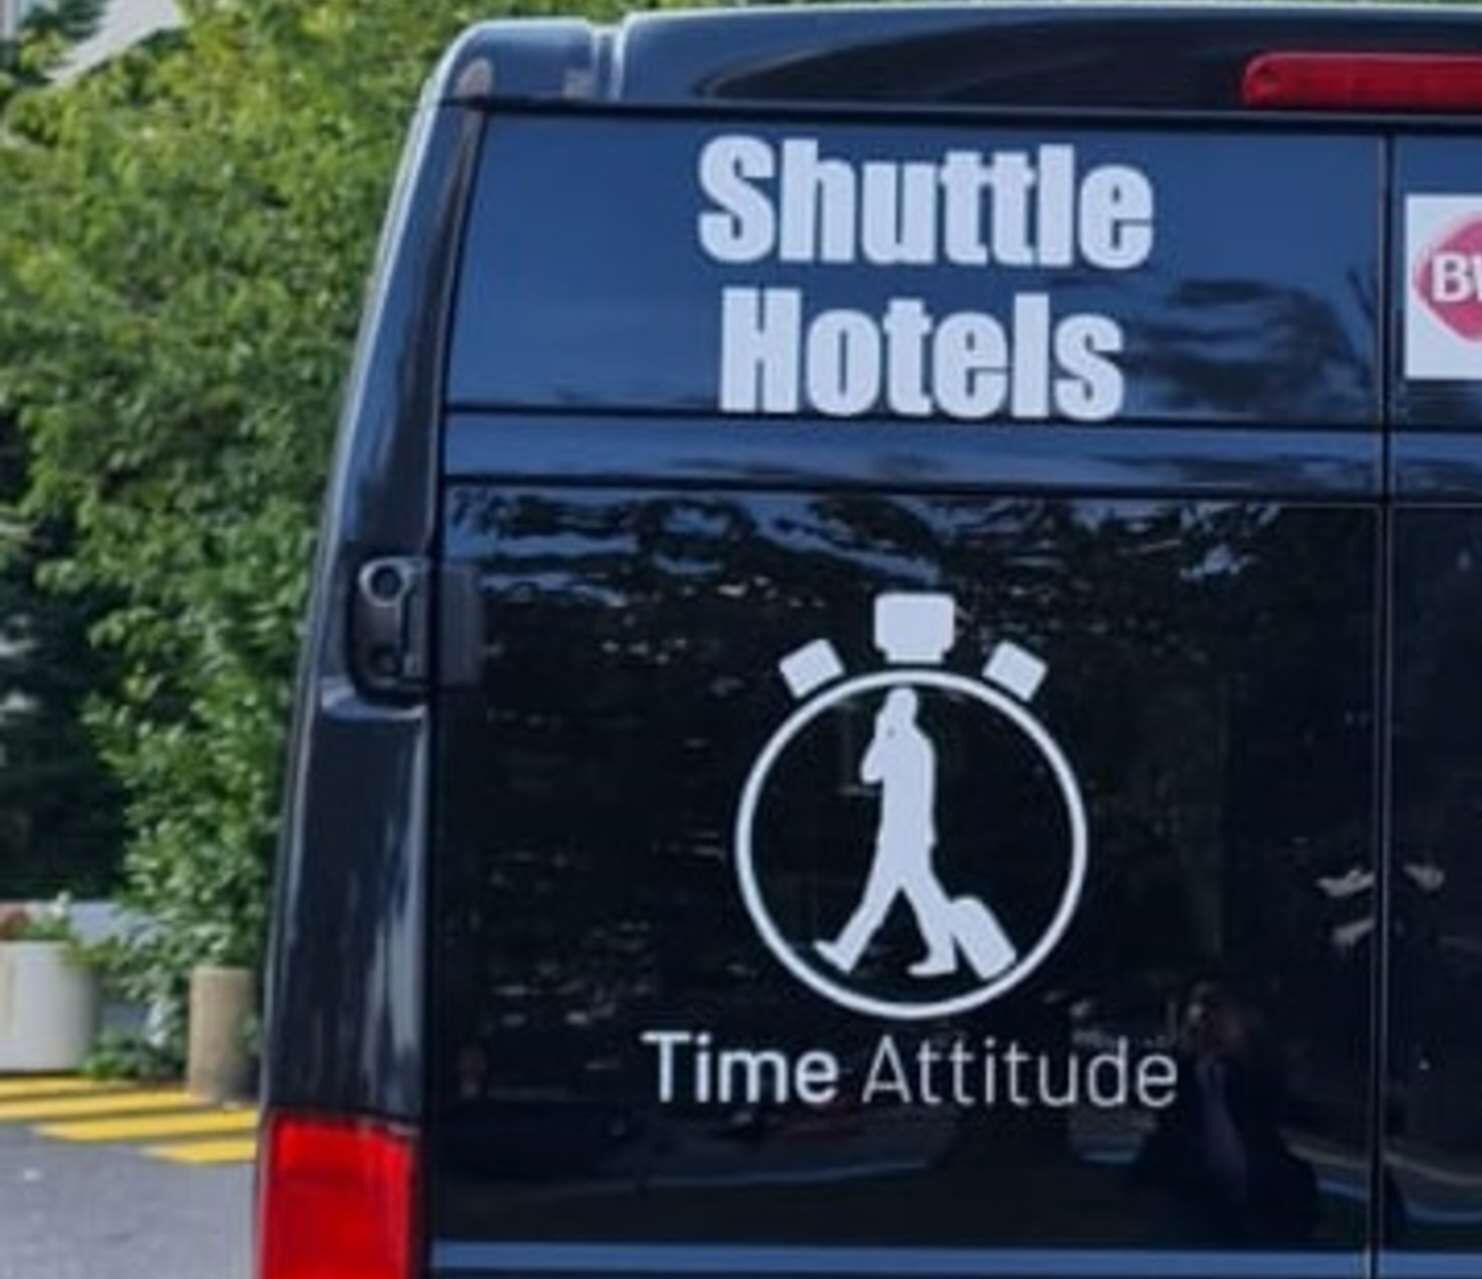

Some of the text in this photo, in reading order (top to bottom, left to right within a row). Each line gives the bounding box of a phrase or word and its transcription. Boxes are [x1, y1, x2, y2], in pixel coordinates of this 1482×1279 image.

[699, 135, 1155, 269] Shuttle
[719, 287, 1125, 420] Hotels
[640, 1031, 1178, 1108] Time Attitude
